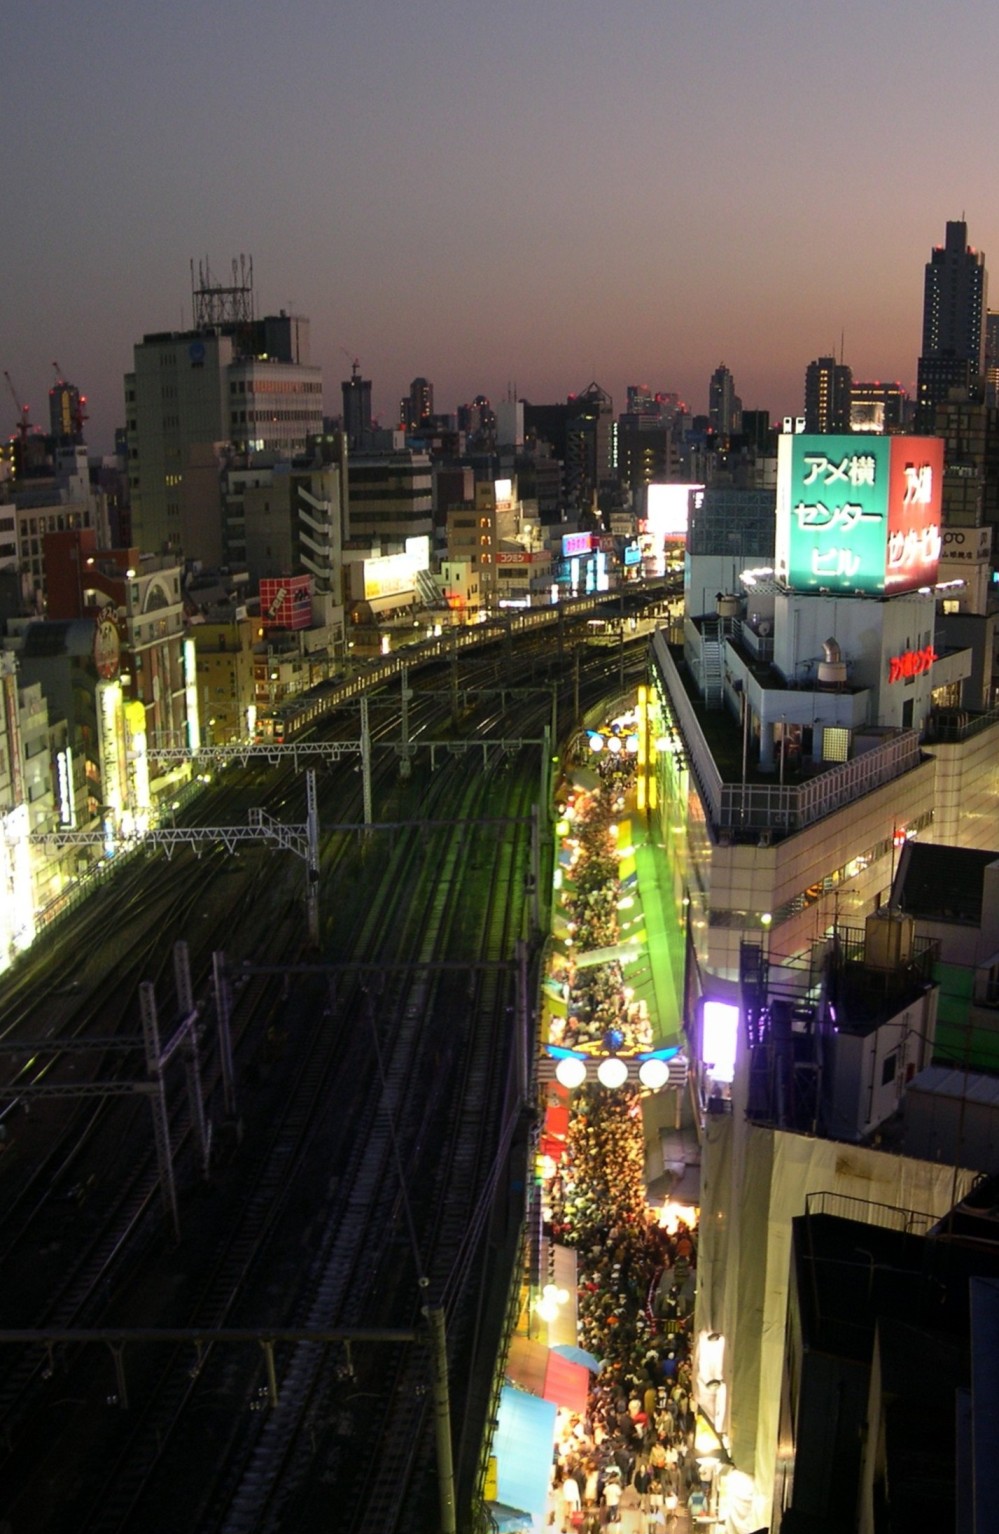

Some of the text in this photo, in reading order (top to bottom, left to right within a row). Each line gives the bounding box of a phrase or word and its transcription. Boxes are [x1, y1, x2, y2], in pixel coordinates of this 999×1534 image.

[802, 455, 876, 486] アメ横
[794, 501, 882, 532] センター
[811, 547, 861, 577] ビル
